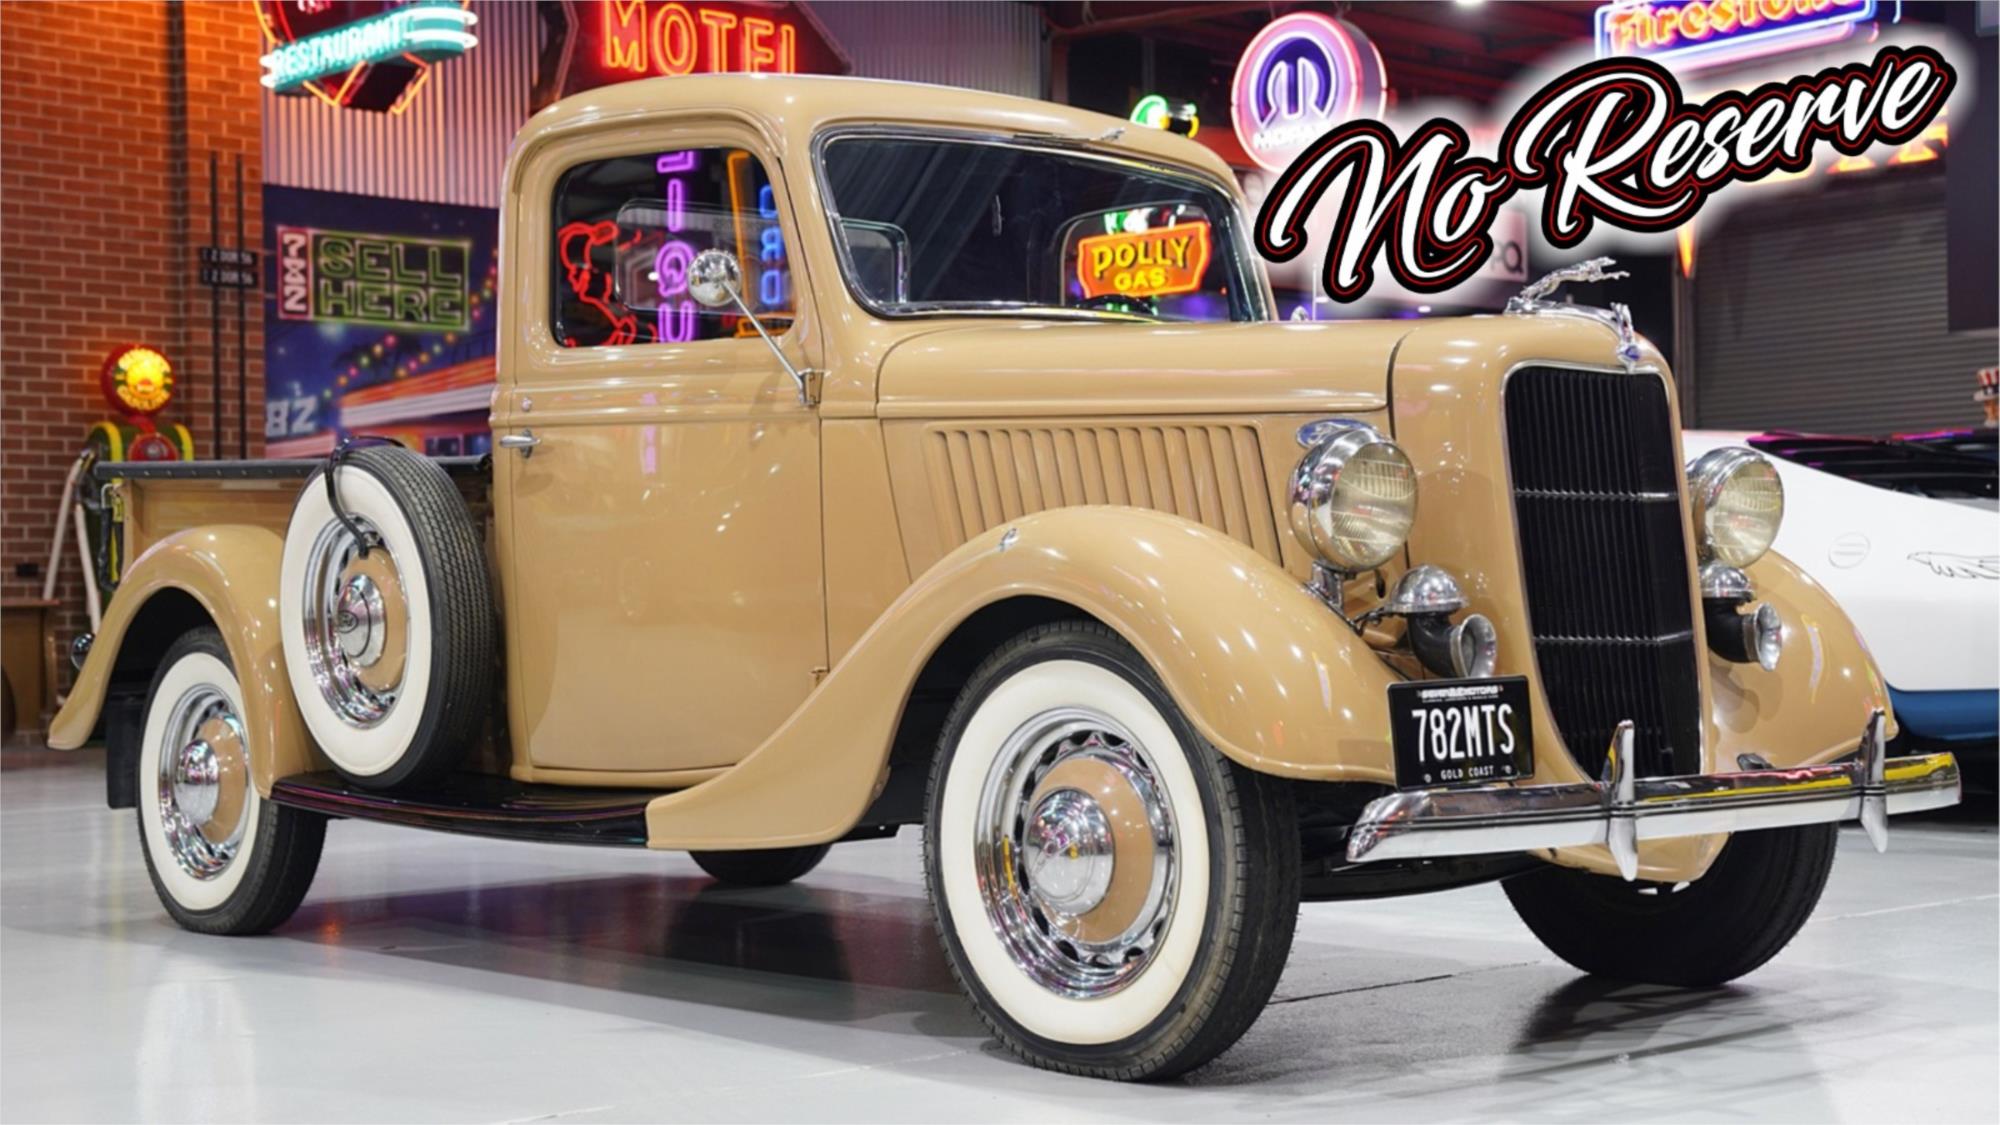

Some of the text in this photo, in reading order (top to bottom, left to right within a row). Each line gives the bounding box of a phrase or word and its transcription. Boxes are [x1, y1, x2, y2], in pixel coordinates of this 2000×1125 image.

[271, 13, 412, 84] RESTAURANT
[1606, 0, 1858, 57] Firesto
[319, 237, 462, 287] SELL
[1091, 236, 1192, 279] POLLY
[1113, 266, 1167, 291] GAS
[319, 278, 463, 325] HERE
[1411, 703, 1515, 762] 782MTS
[1440, 765, 1495, 780] GOLD COAST
